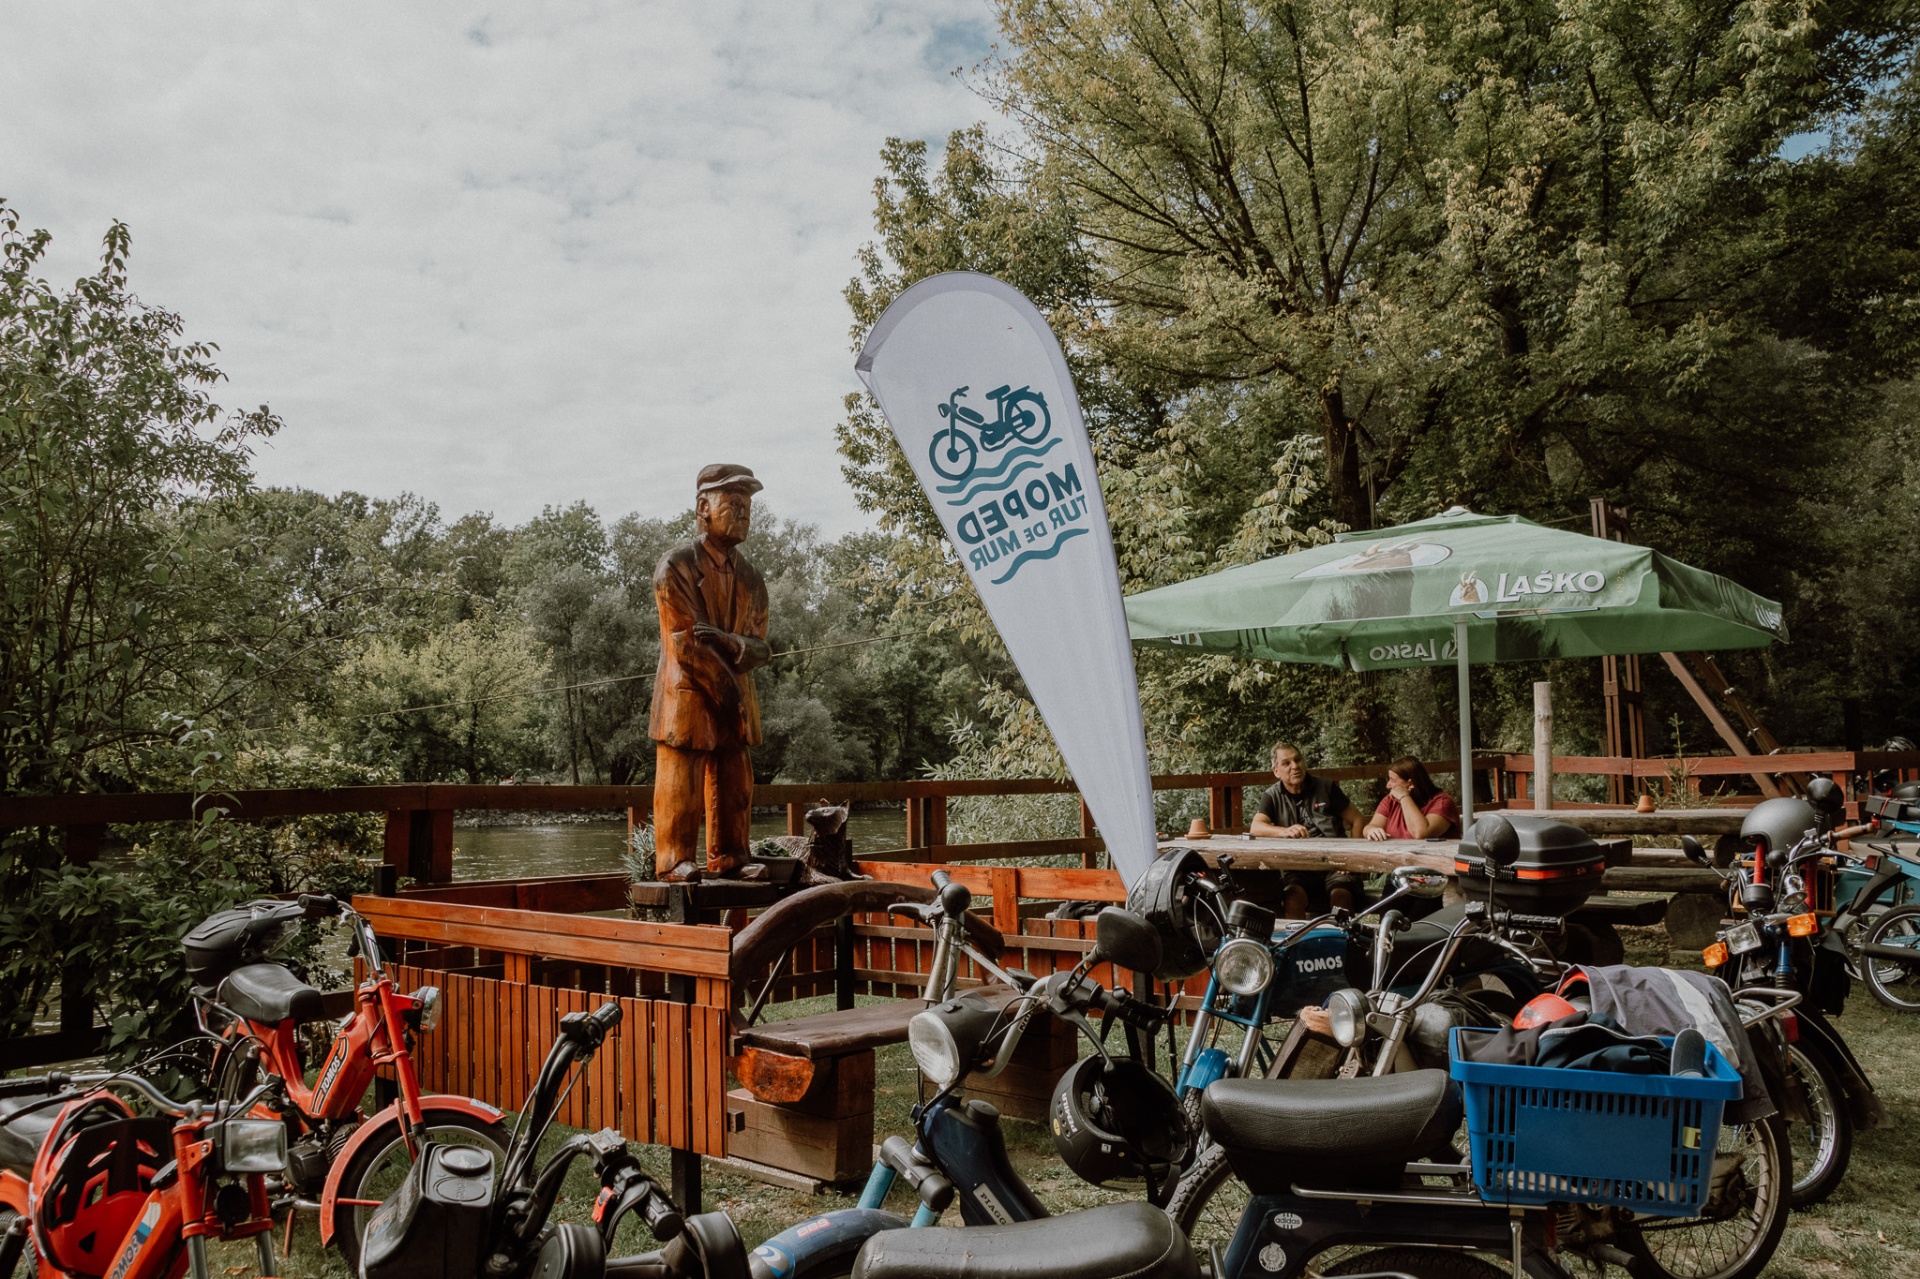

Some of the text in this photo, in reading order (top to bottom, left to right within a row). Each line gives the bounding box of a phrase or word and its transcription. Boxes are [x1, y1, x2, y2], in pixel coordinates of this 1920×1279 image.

[1495, 570, 1606, 603] LAŠKO
[1295, 955, 1343, 973] TOMOS
[321, 1055, 340, 1093] TOMOS
[980, 1193, 1007, 1225] PIAGG
[1275, 1217, 1300, 1225] adidas
[111, 1234, 139, 1279] OMOS
